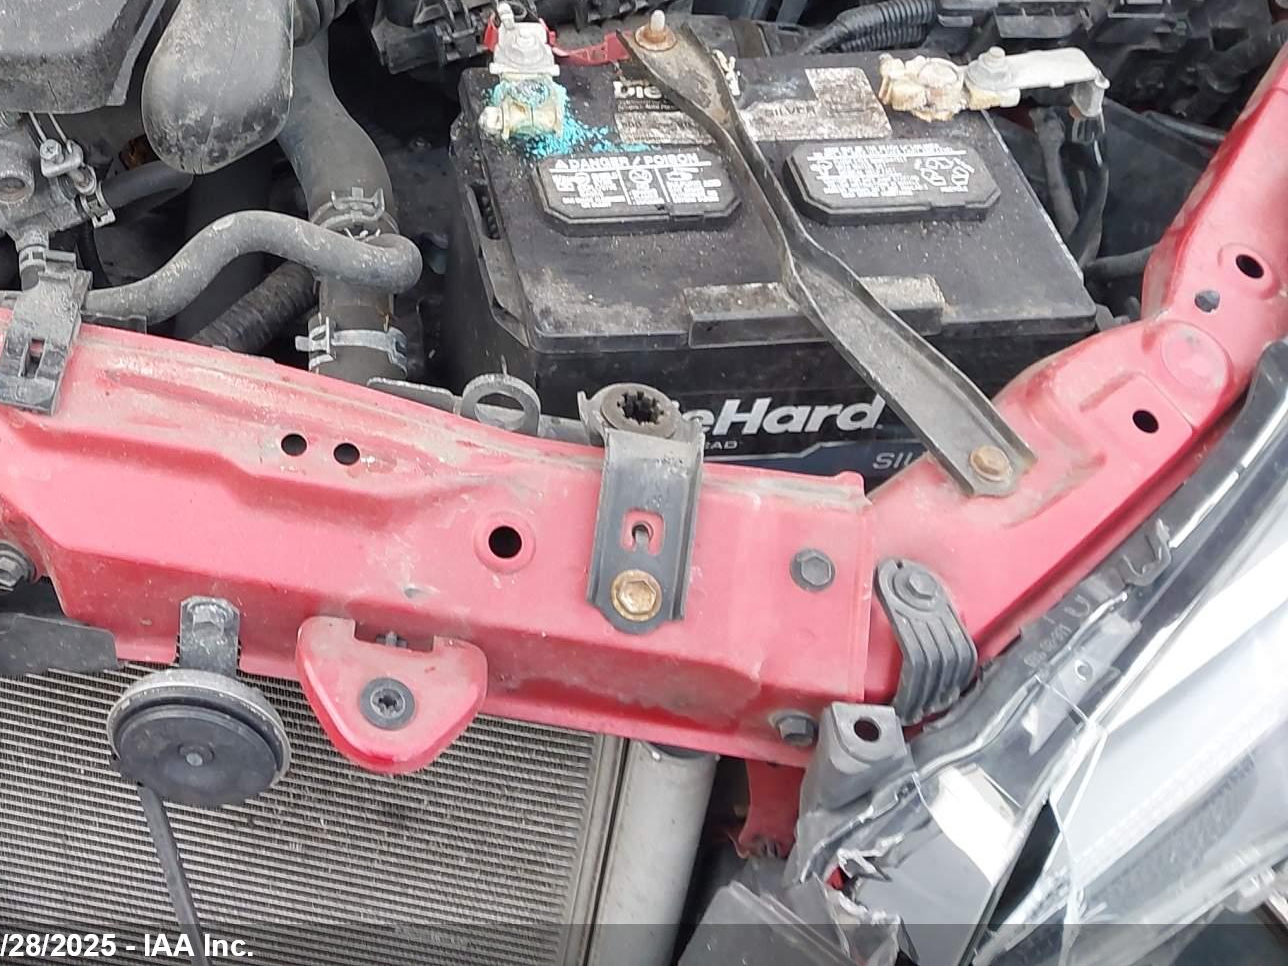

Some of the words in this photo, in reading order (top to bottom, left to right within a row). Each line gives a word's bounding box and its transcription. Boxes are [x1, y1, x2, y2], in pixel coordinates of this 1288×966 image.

[613, 81, 663, 99] Die
[765, 104, 818, 117] SILVER
[568, 156, 629, 170] DANGER
[643, 152, 700, 166] POISON
[681, 394, 887, 436] eHard
[872, 451, 914, 470] SIL
